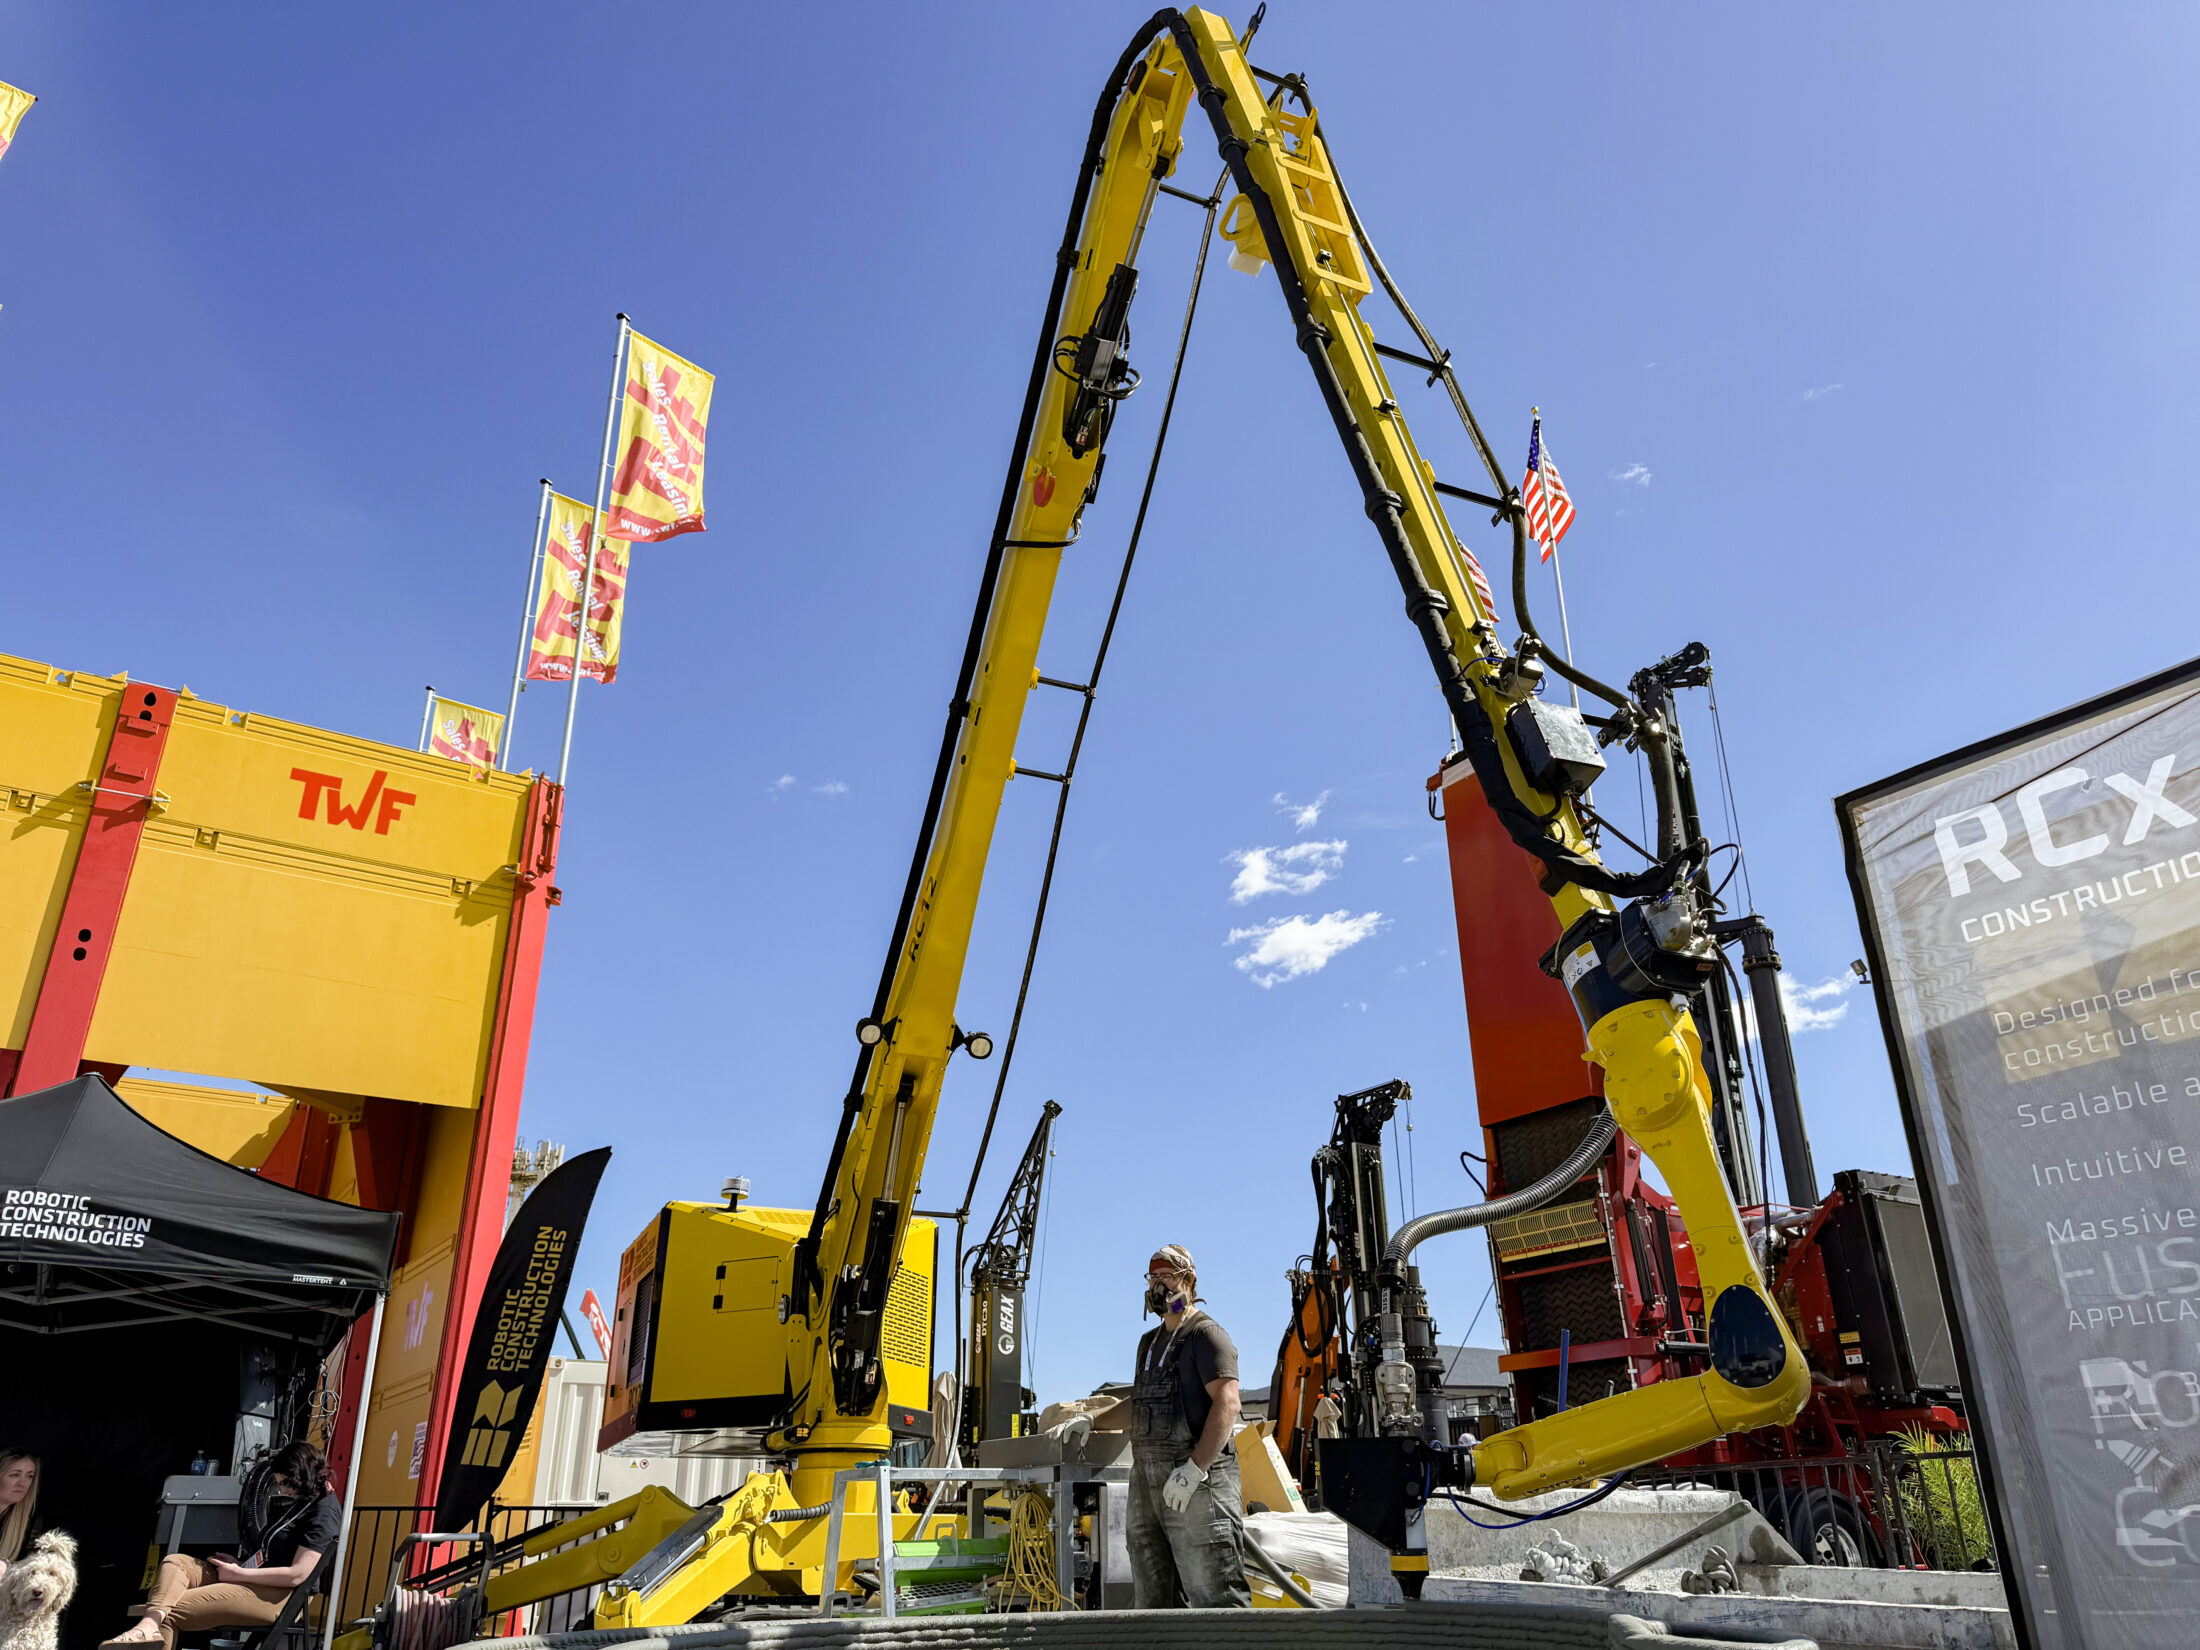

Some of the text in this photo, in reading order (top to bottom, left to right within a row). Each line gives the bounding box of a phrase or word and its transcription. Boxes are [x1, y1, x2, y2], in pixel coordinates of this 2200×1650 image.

[652, 413, 686, 469] Rental
[560, 520, 587, 563] Sales
[443, 719, 466, 751] Sales
[289, 767, 417, 836] TWF
[1994, 974, 2158, 1036] Designed
[2017, 1081, 2169, 1128] Scalable
[2032, 1145, 2188, 1187] Intuitive
[1, 1205, 152, 1233] CONSTRUCTION
[5, 1190, 92, 1212] ROBOTIC
[0, 1222, 145, 1249] TECHNOLOGIES
[2046, 1206, 2198, 1245] Massive
[500, 1225, 553, 1372] CONSTRUCTION
[514, 1230, 567, 1373] TECHNOLOGIES
[999, 1293, 1015, 1334] GEAX
[2068, 1298, 2200, 1332] APPLICA
[486, 1288, 521, 1371] ROBOTIC
